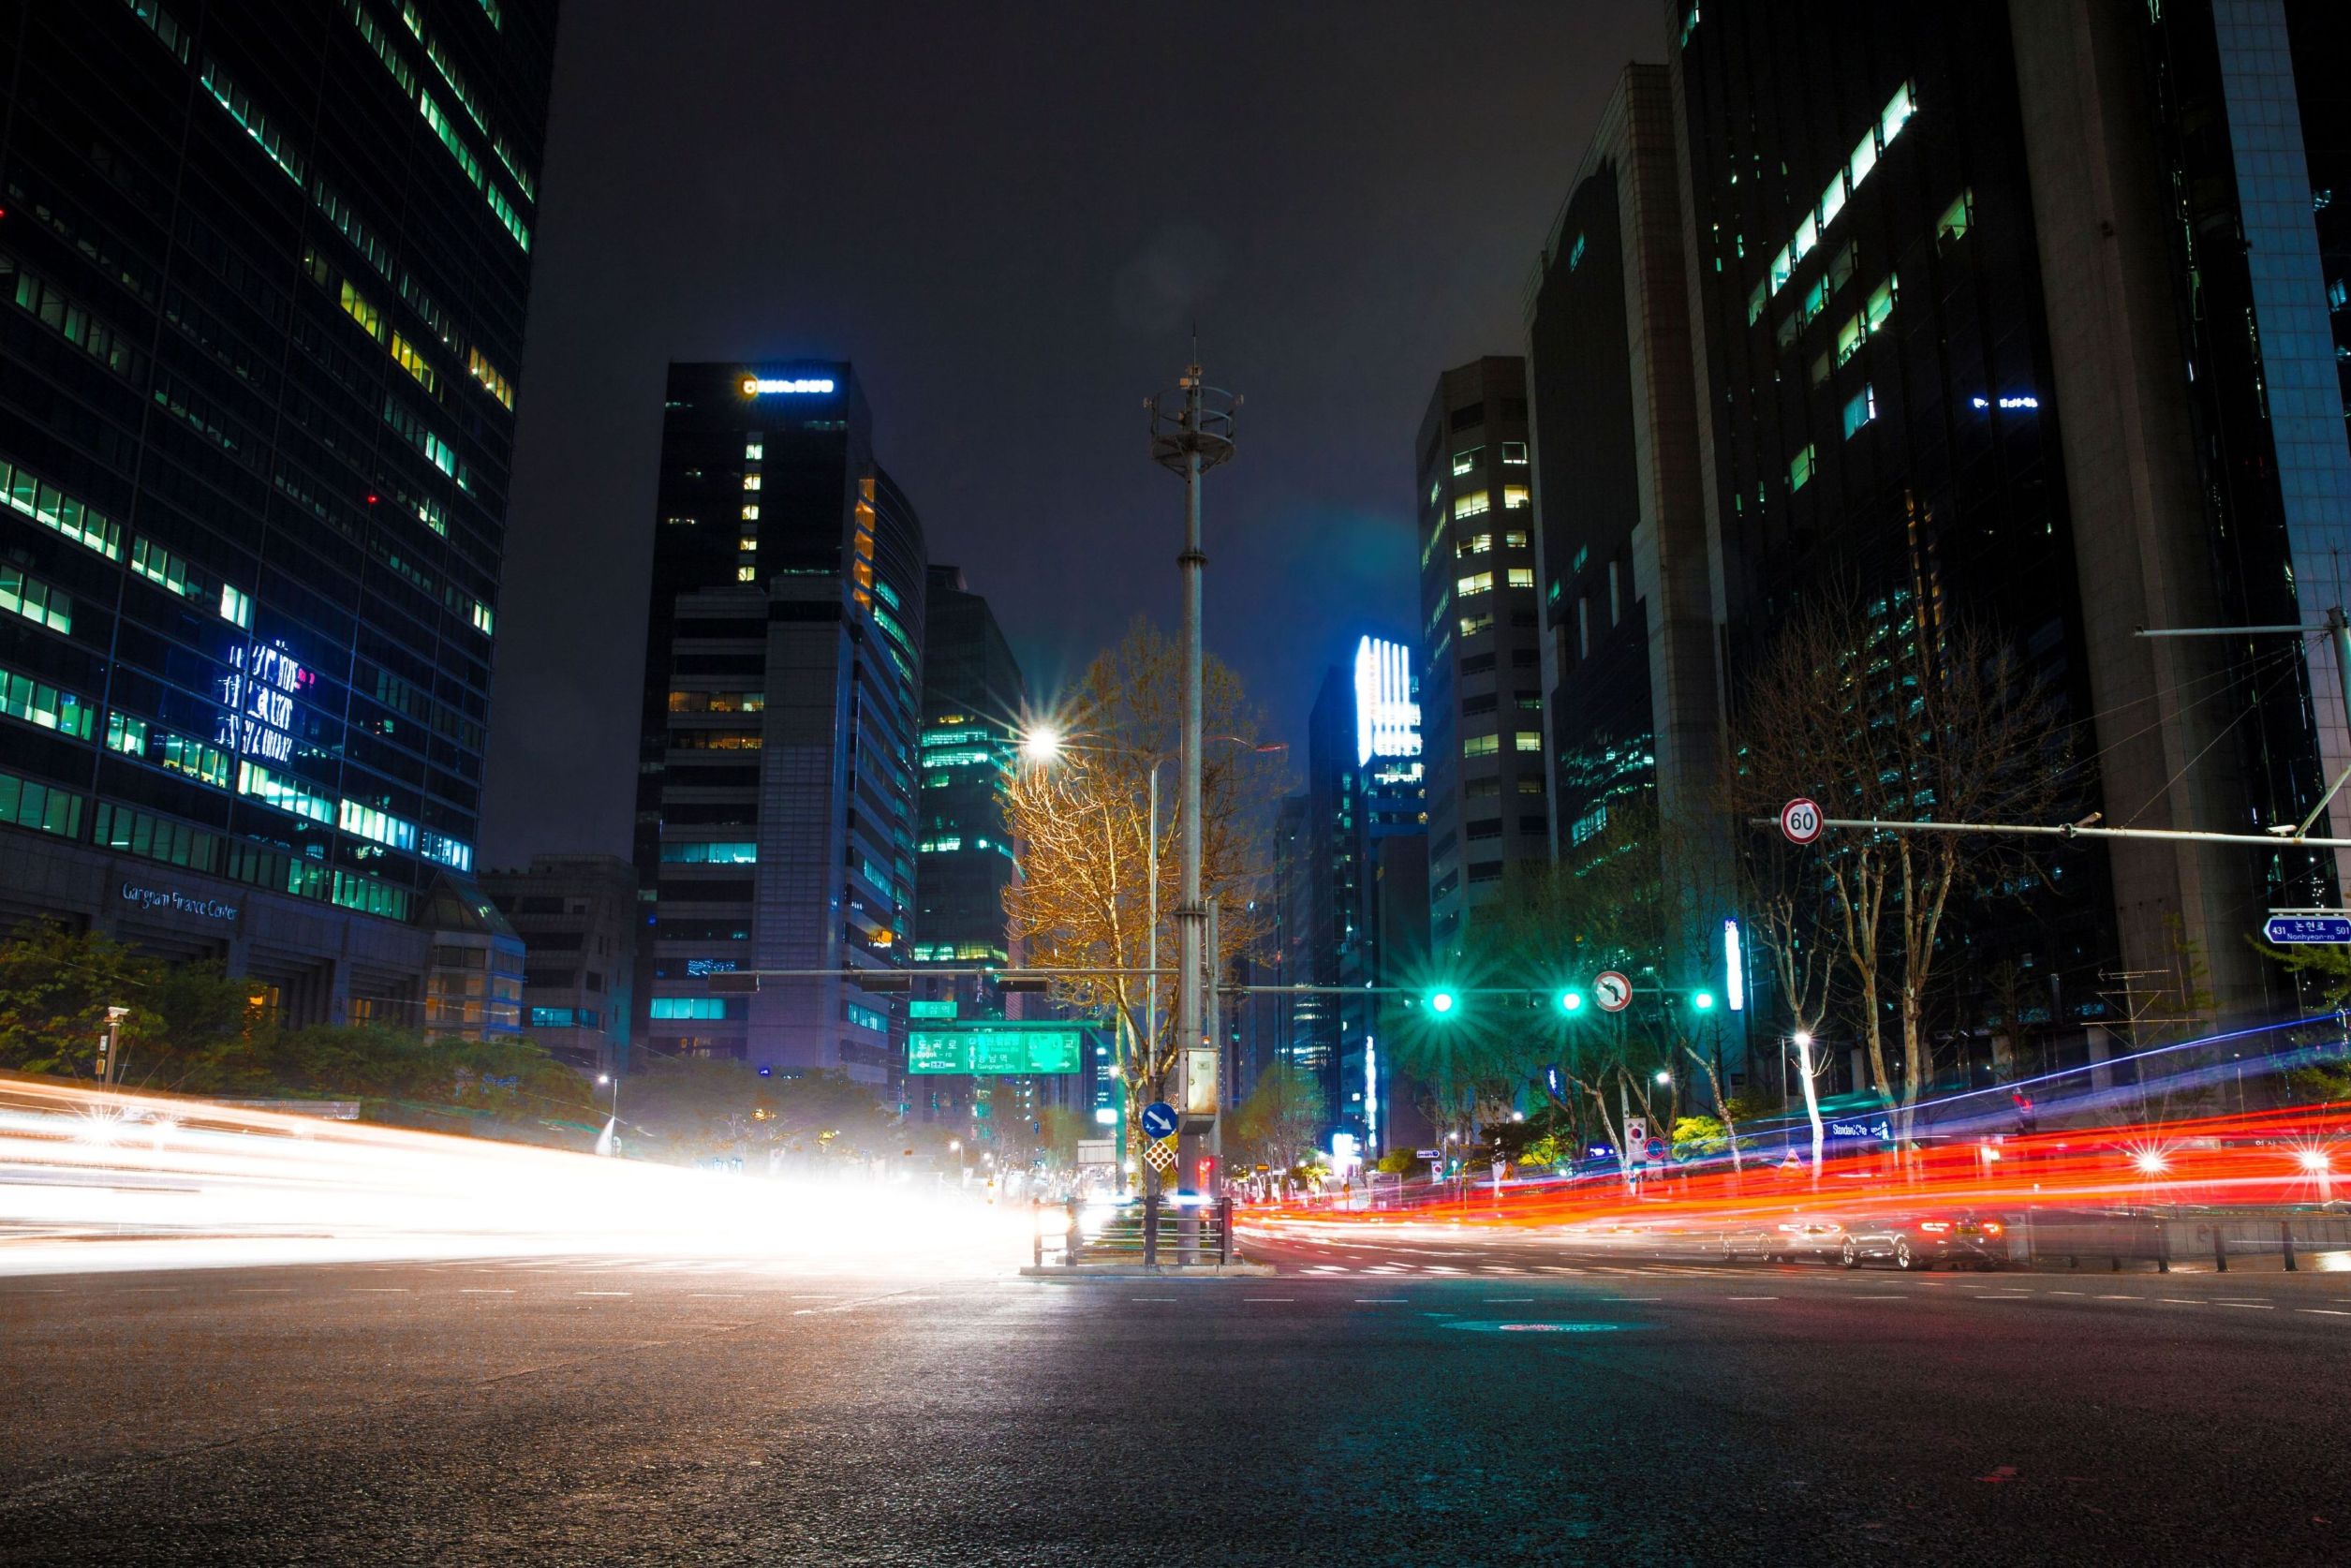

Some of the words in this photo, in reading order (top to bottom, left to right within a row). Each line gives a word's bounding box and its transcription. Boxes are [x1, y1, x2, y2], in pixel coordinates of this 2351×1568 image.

[1791, 812, 1813, 831] 60
[2271, 926, 2286, 935] 431
[2294, 921, 2327, 932] 논현로
[2335, 926, 2349, 935] 501
